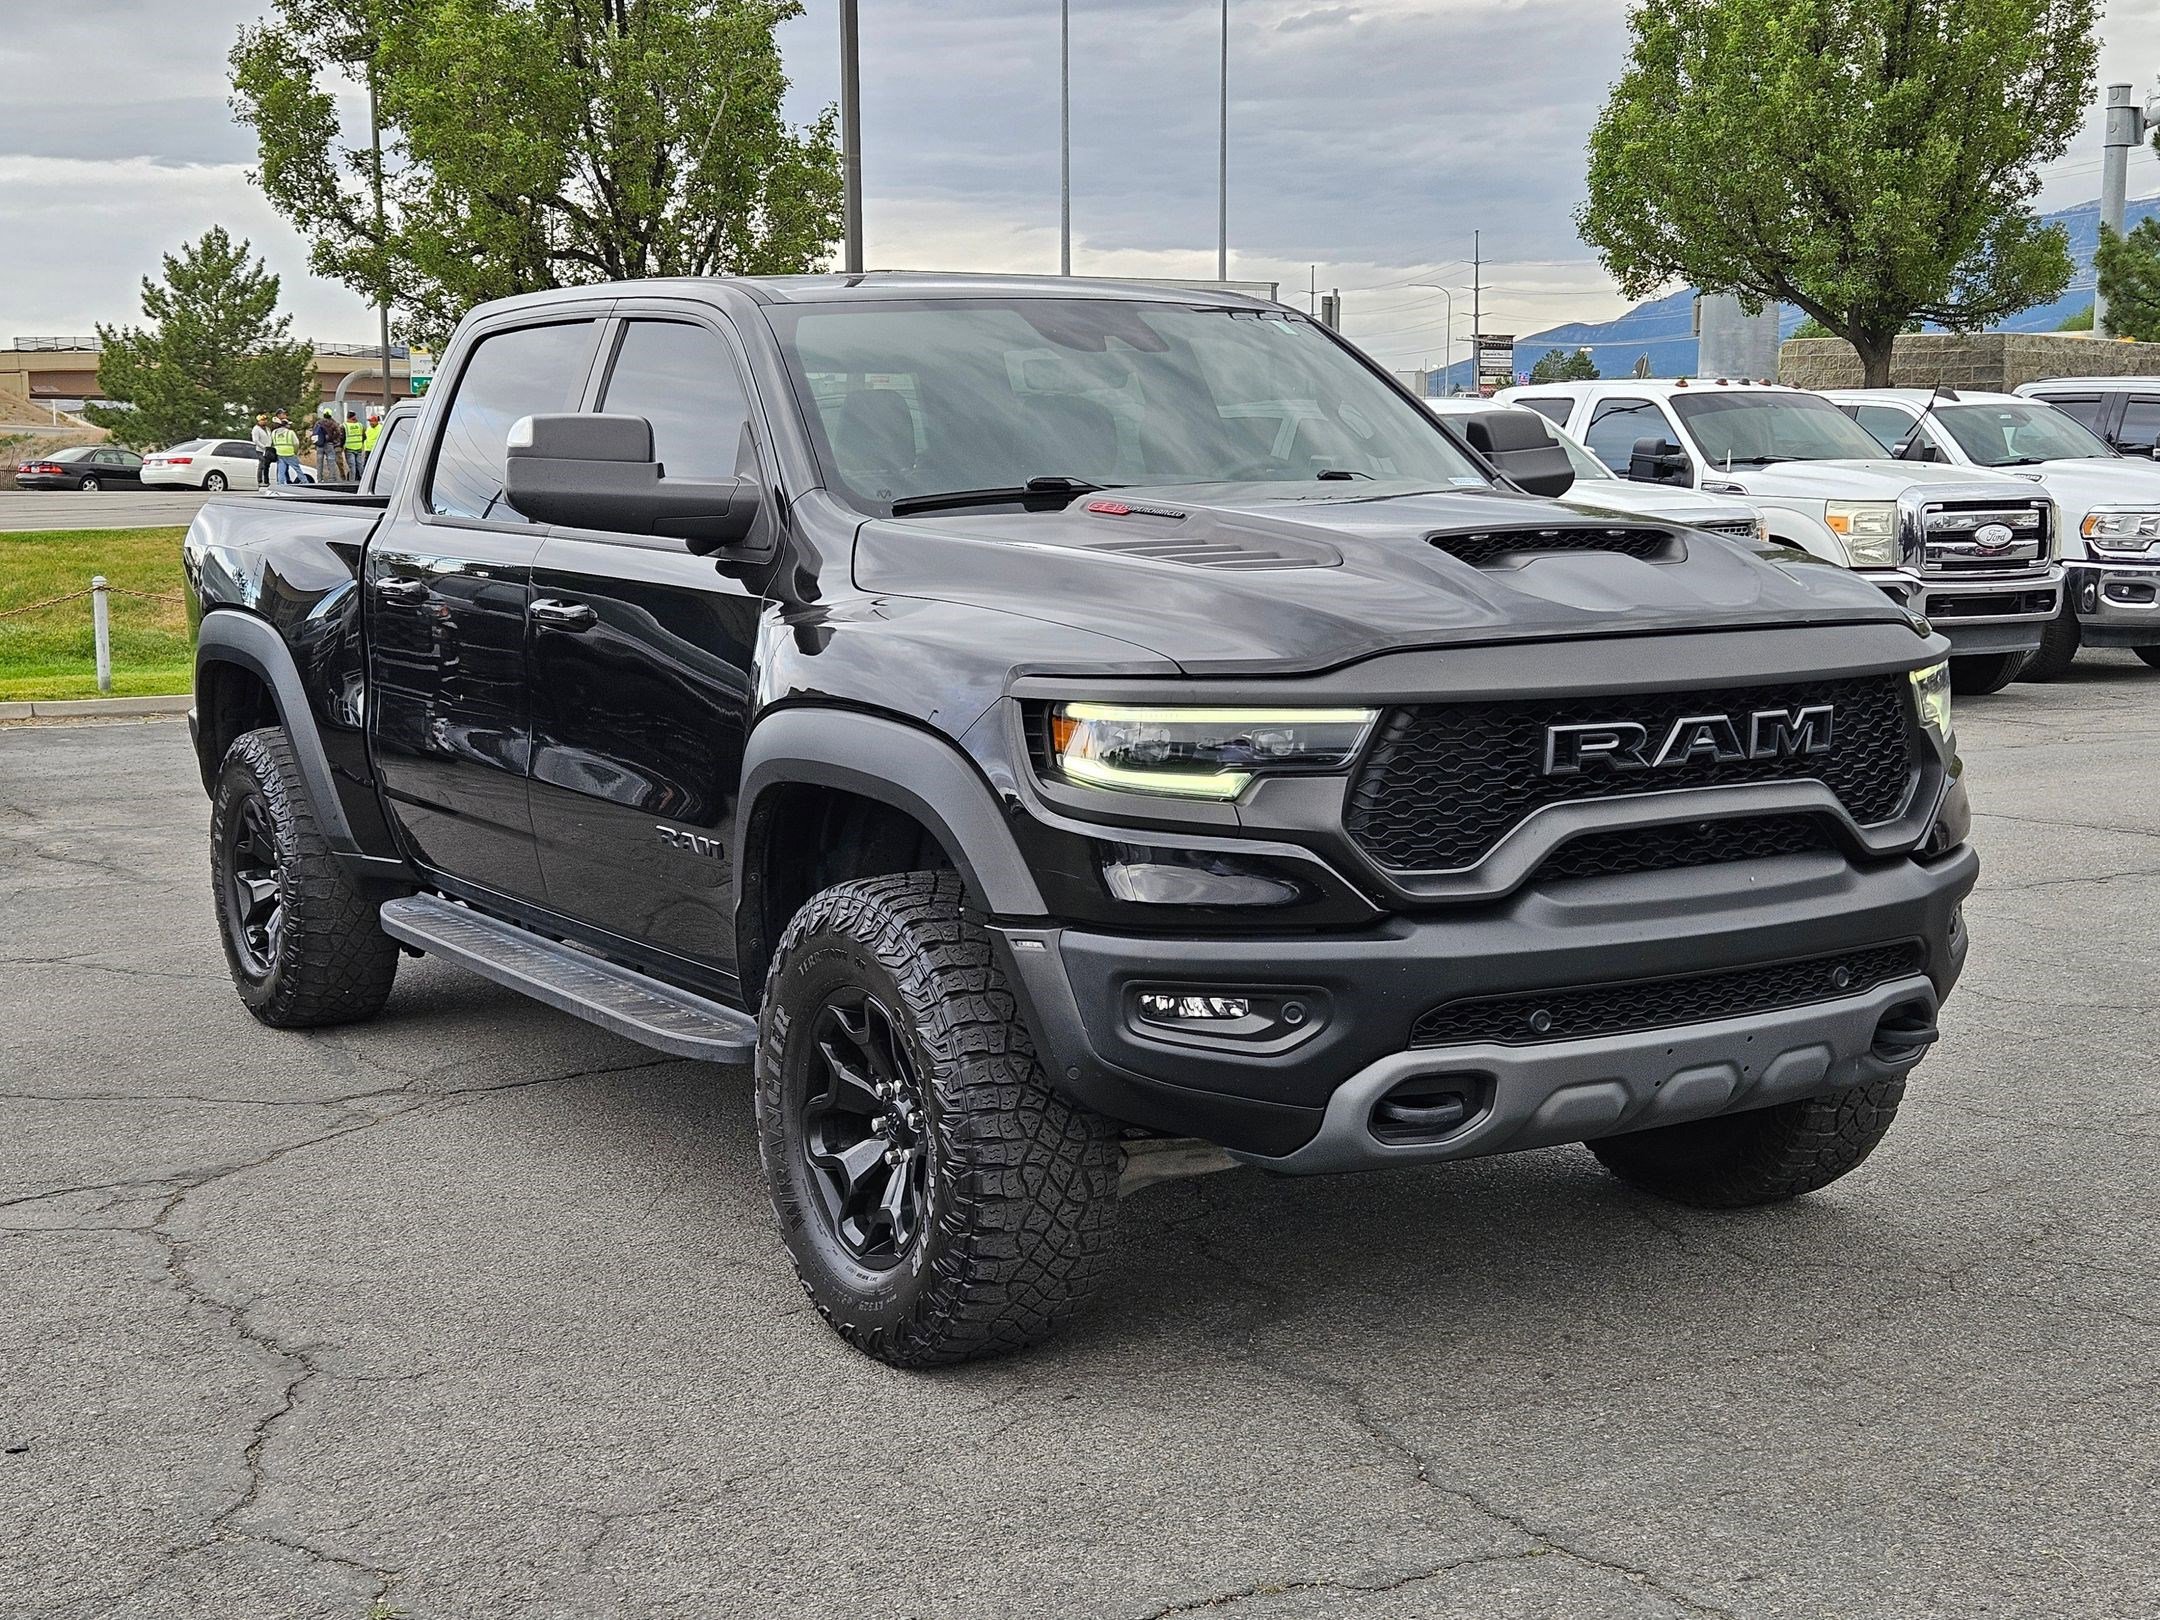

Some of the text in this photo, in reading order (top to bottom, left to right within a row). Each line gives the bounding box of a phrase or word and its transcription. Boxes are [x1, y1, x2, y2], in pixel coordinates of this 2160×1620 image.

[1124, 504, 1183, 517] SUPERCHARGED
[1985, 529, 2007, 542] Ford
[1543, 705, 1834, 775] RAM
[656, 825, 725, 859] RAM
[765, 1004, 805, 1234] WRANGLER
